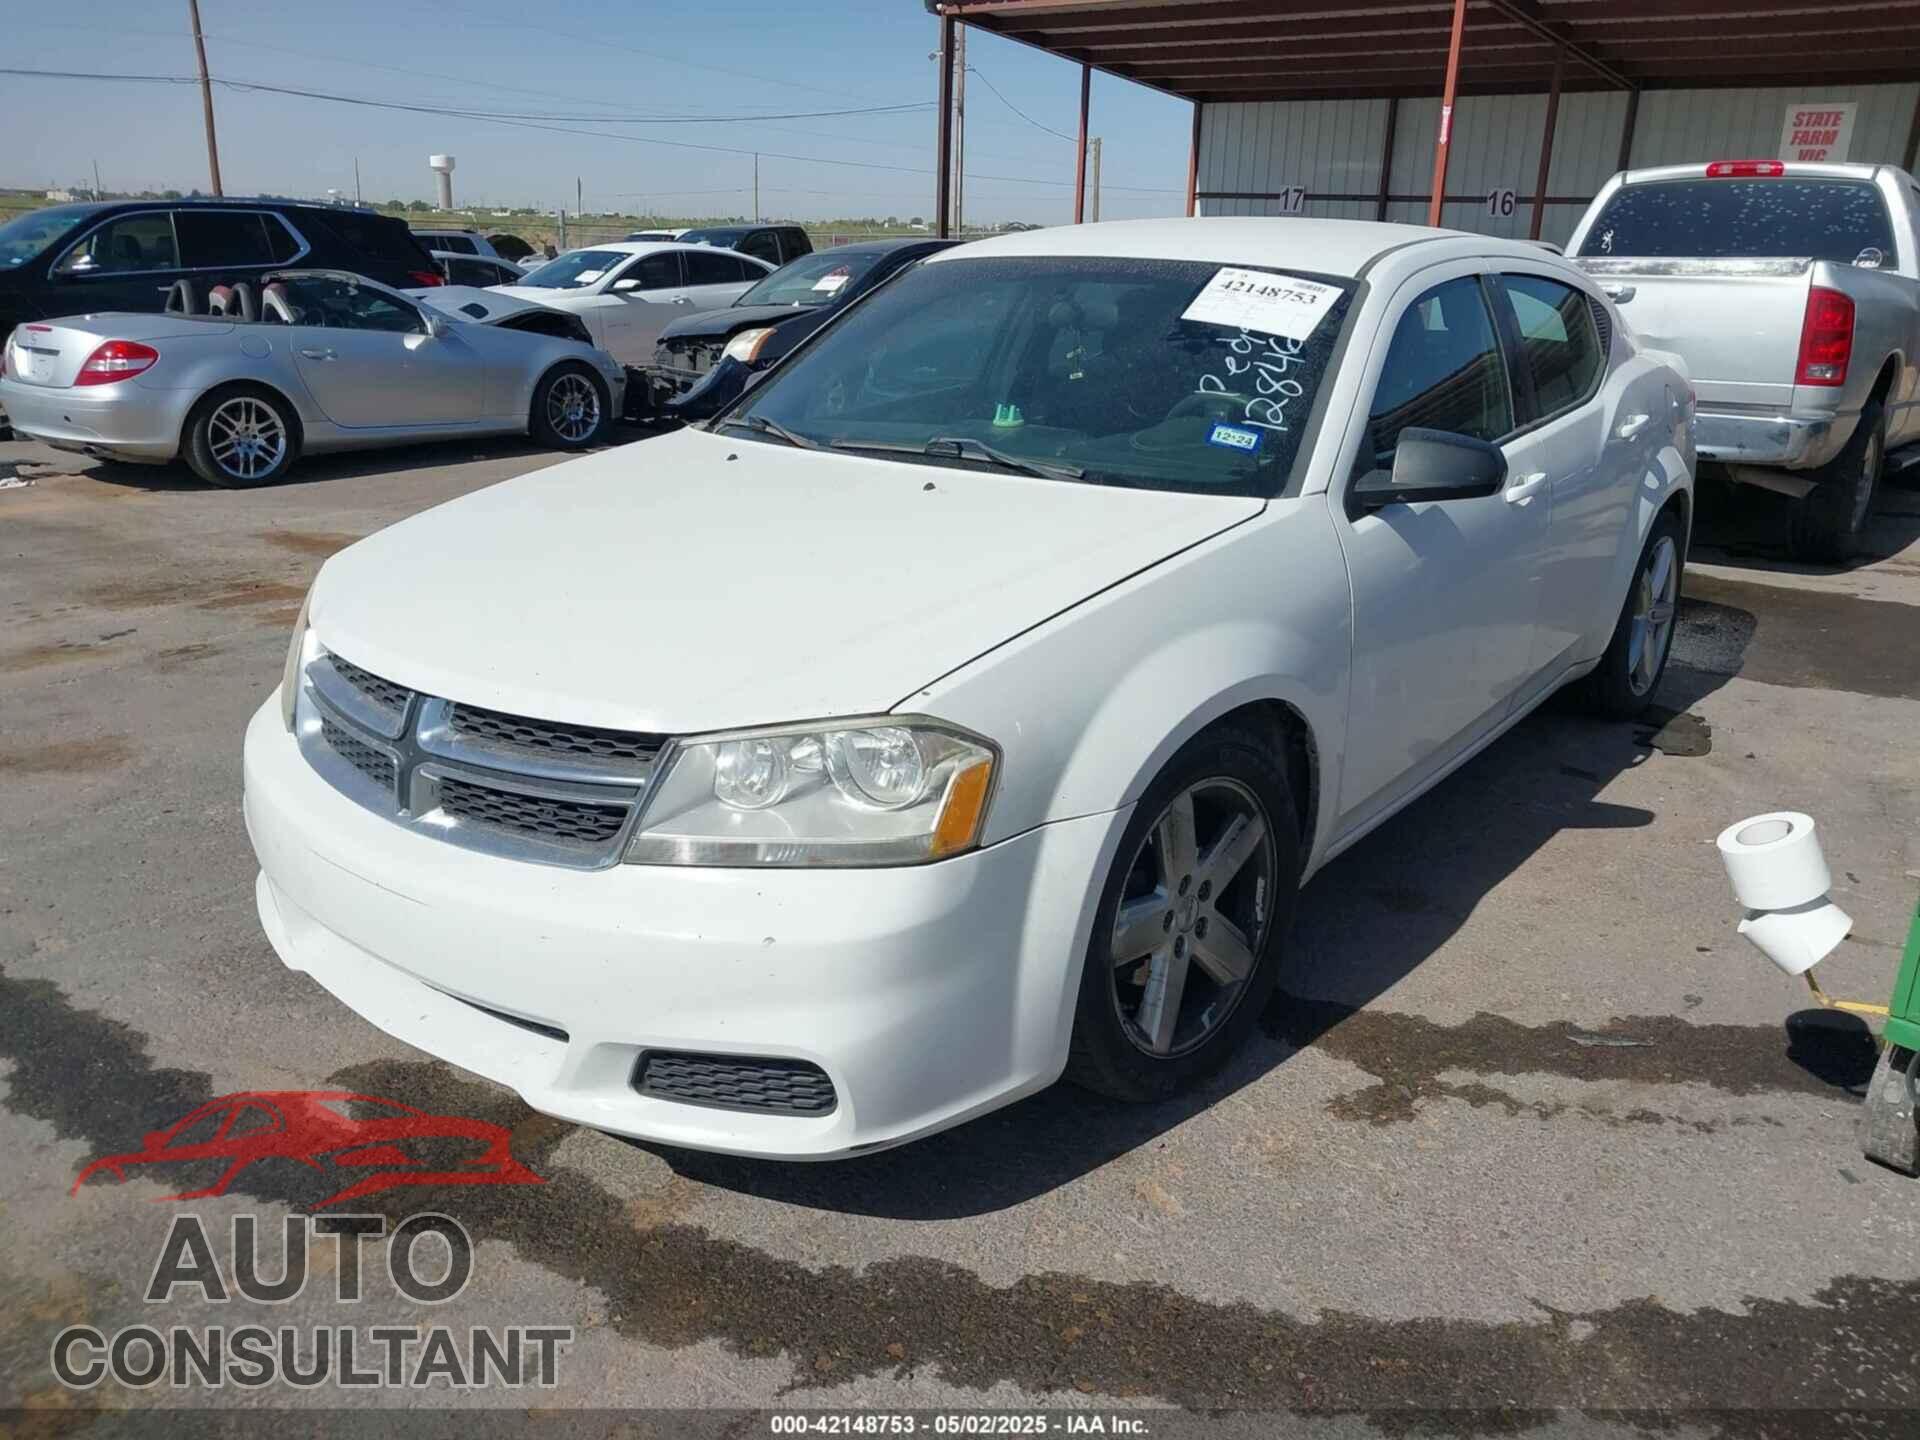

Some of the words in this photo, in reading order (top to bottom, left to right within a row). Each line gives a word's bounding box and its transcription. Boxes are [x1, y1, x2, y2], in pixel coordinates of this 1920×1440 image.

[1793, 111, 1844, 128] STATE
[1791, 129, 1838, 146] FARM
[1280, 187, 1304, 211] 17
[1488, 191, 1514, 216] 16
[1220, 280, 1318, 305] 42148753
